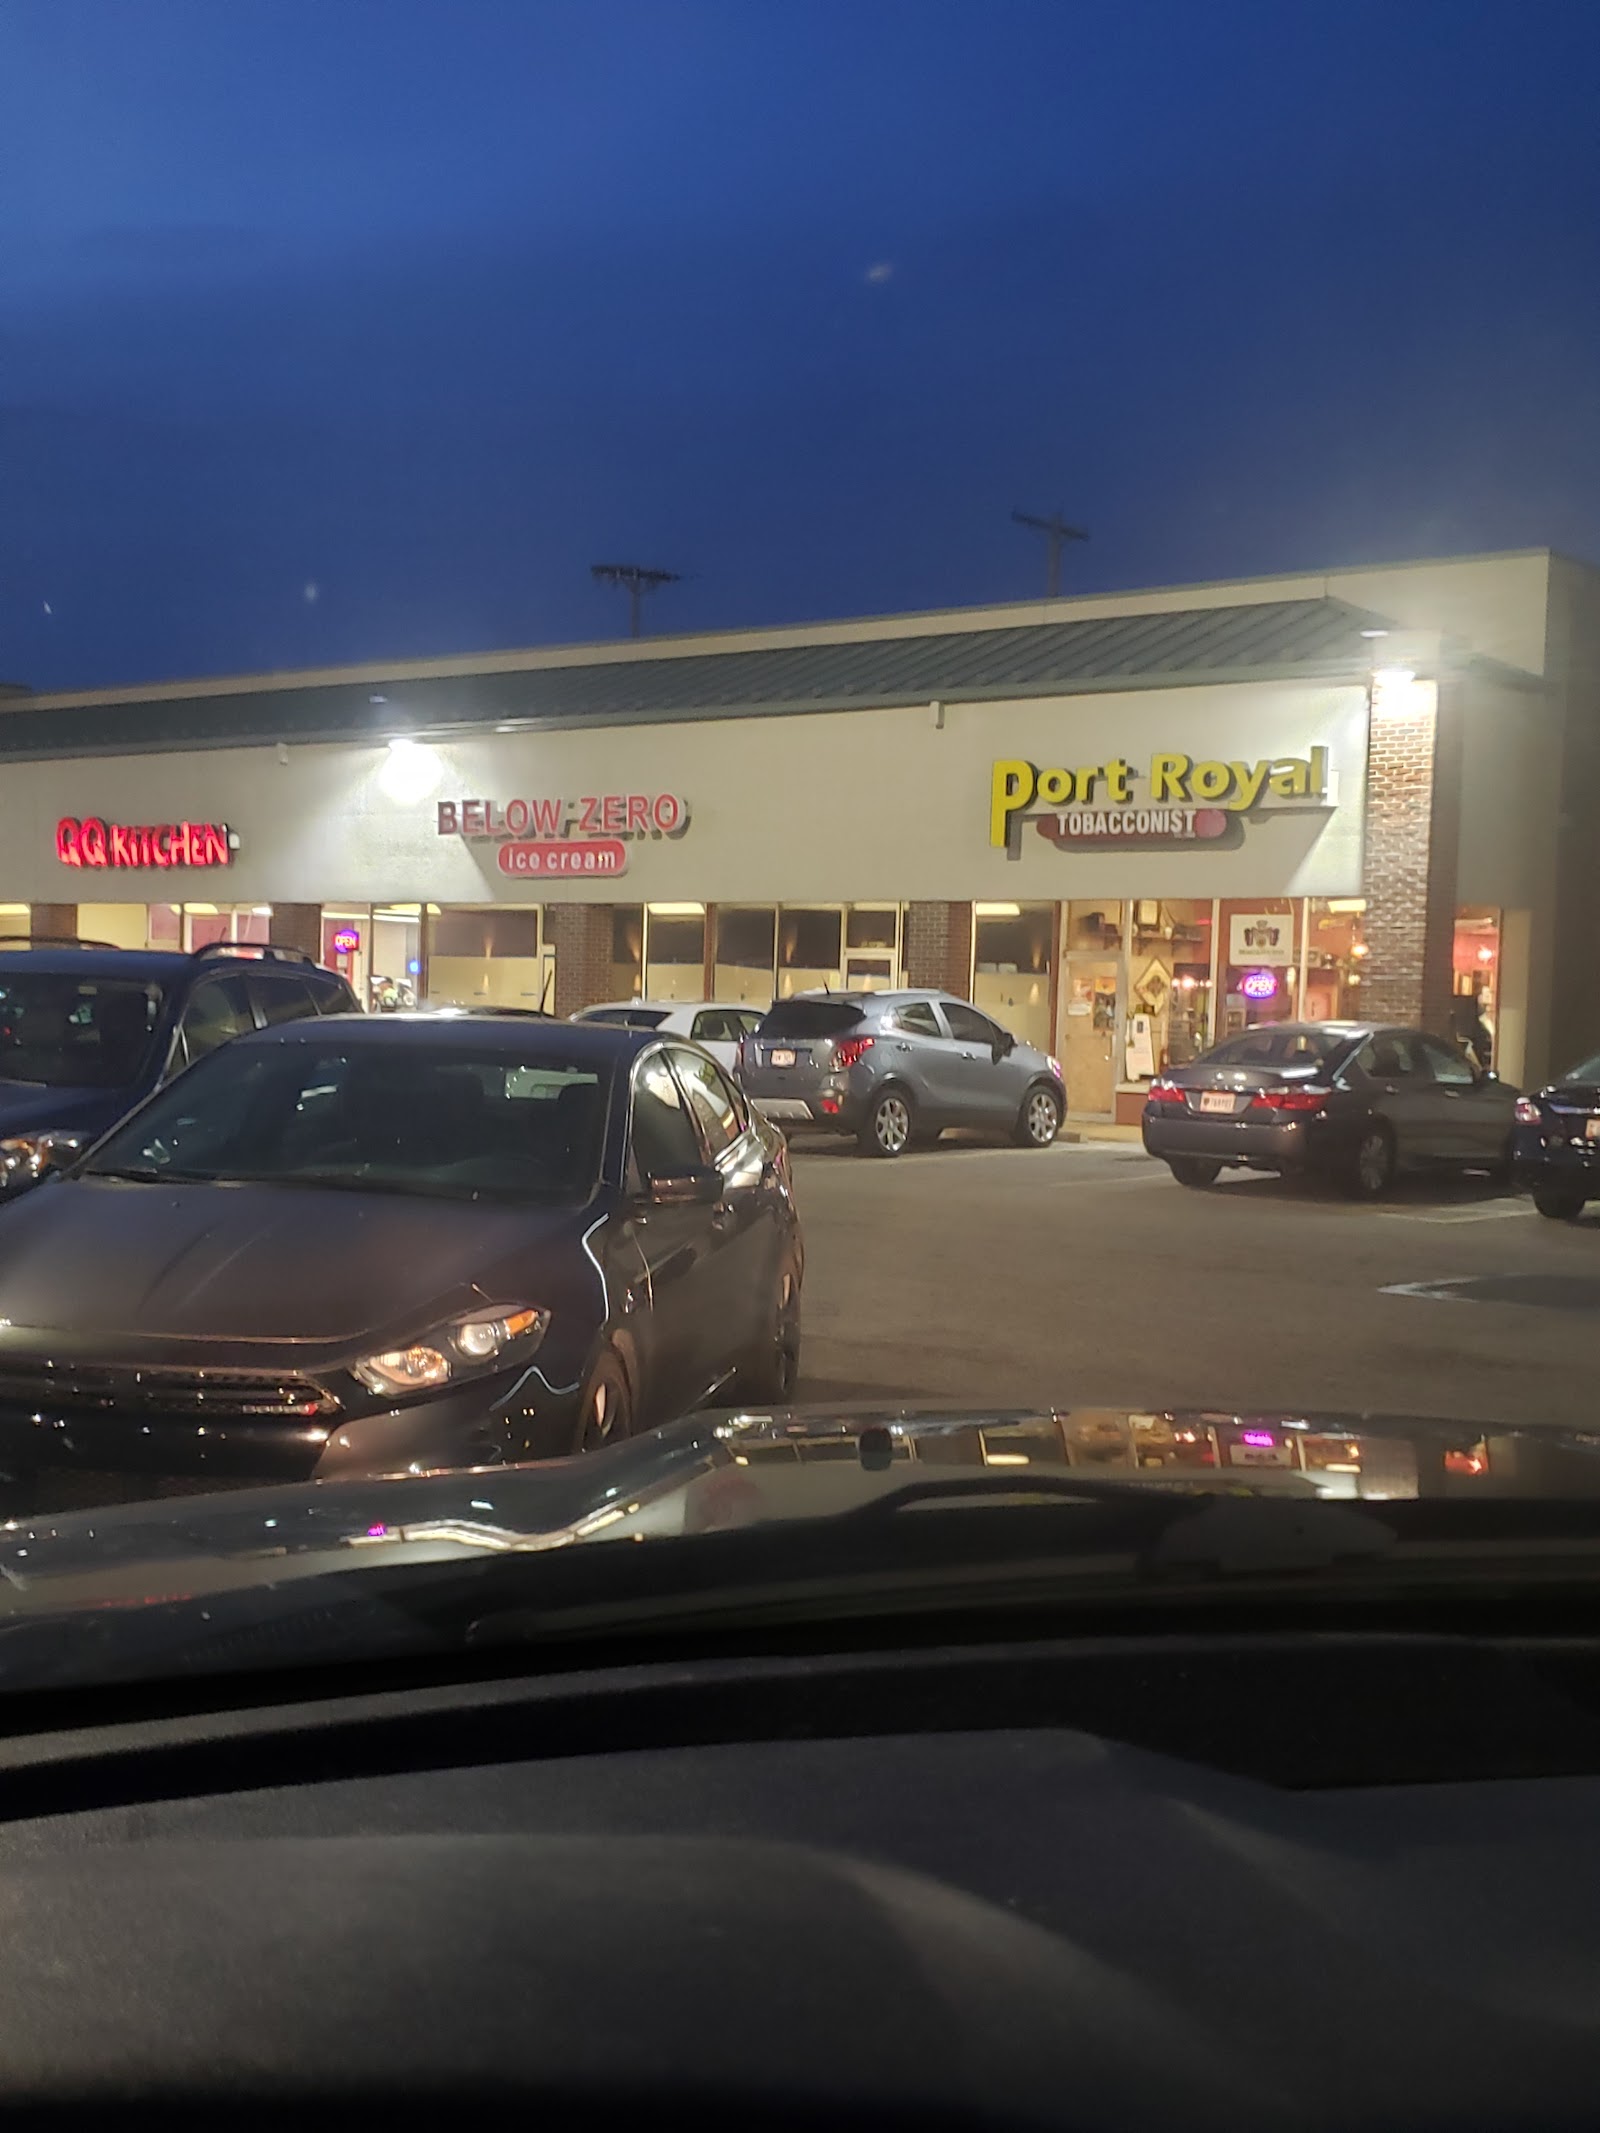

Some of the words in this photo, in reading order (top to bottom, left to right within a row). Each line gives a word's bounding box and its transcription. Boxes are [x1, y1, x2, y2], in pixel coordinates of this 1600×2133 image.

[1150, 746, 1329, 811] Royal
[437, 799, 562, 836] BELOW
[579, 793, 680, 833] ZERO
[1056, 809, 1197, 837] TOBACCONIST
[56, 816, 108, 867] QQ
[111, 820, 229, 867] KITCHEN
[508, 847, 540, 870] ice
[546, 847, 616, 871] cream
[335, 935, 357, 949] OPEN
[1244, 978, 1277, 994] OPEN
